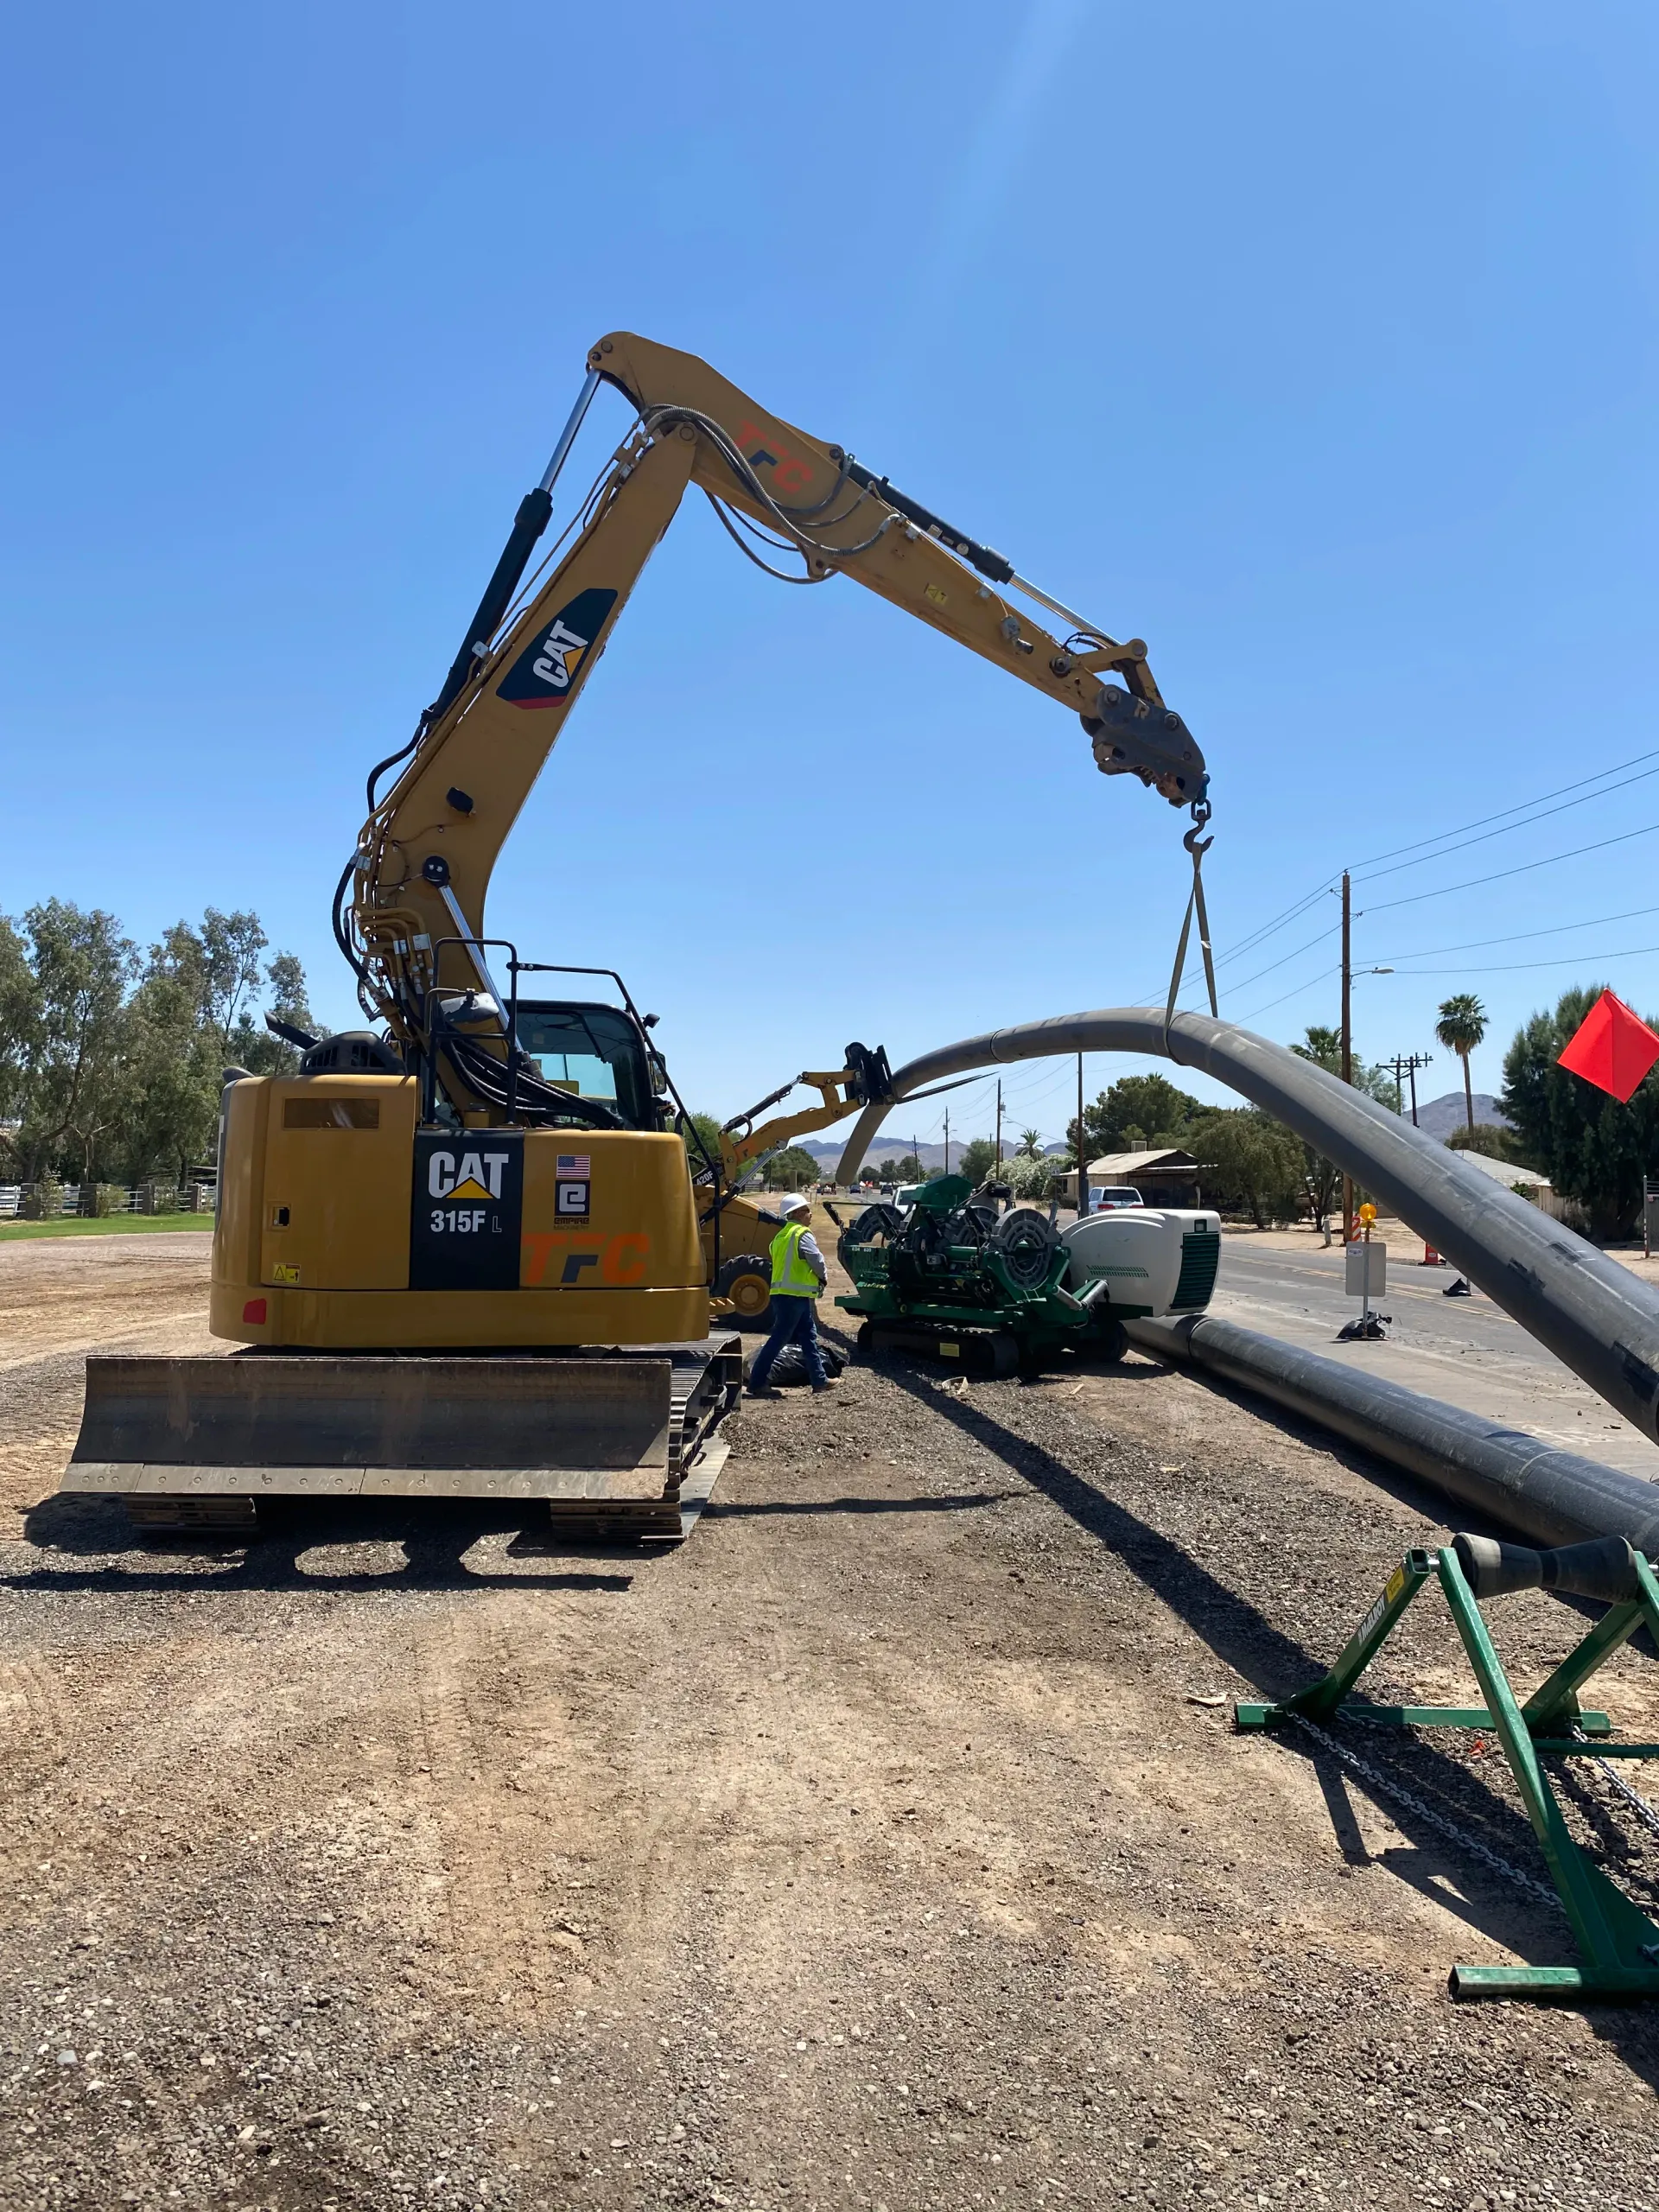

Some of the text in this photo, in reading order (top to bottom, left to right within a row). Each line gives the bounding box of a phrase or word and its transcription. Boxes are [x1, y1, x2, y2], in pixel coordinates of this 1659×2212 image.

[532, 619, 589, 688] CAT
[428, 1151, 510, 1199] CAT
[696, 1171, 713, 1185] 420F
[430, 1210, 502, 1233] 315F L
